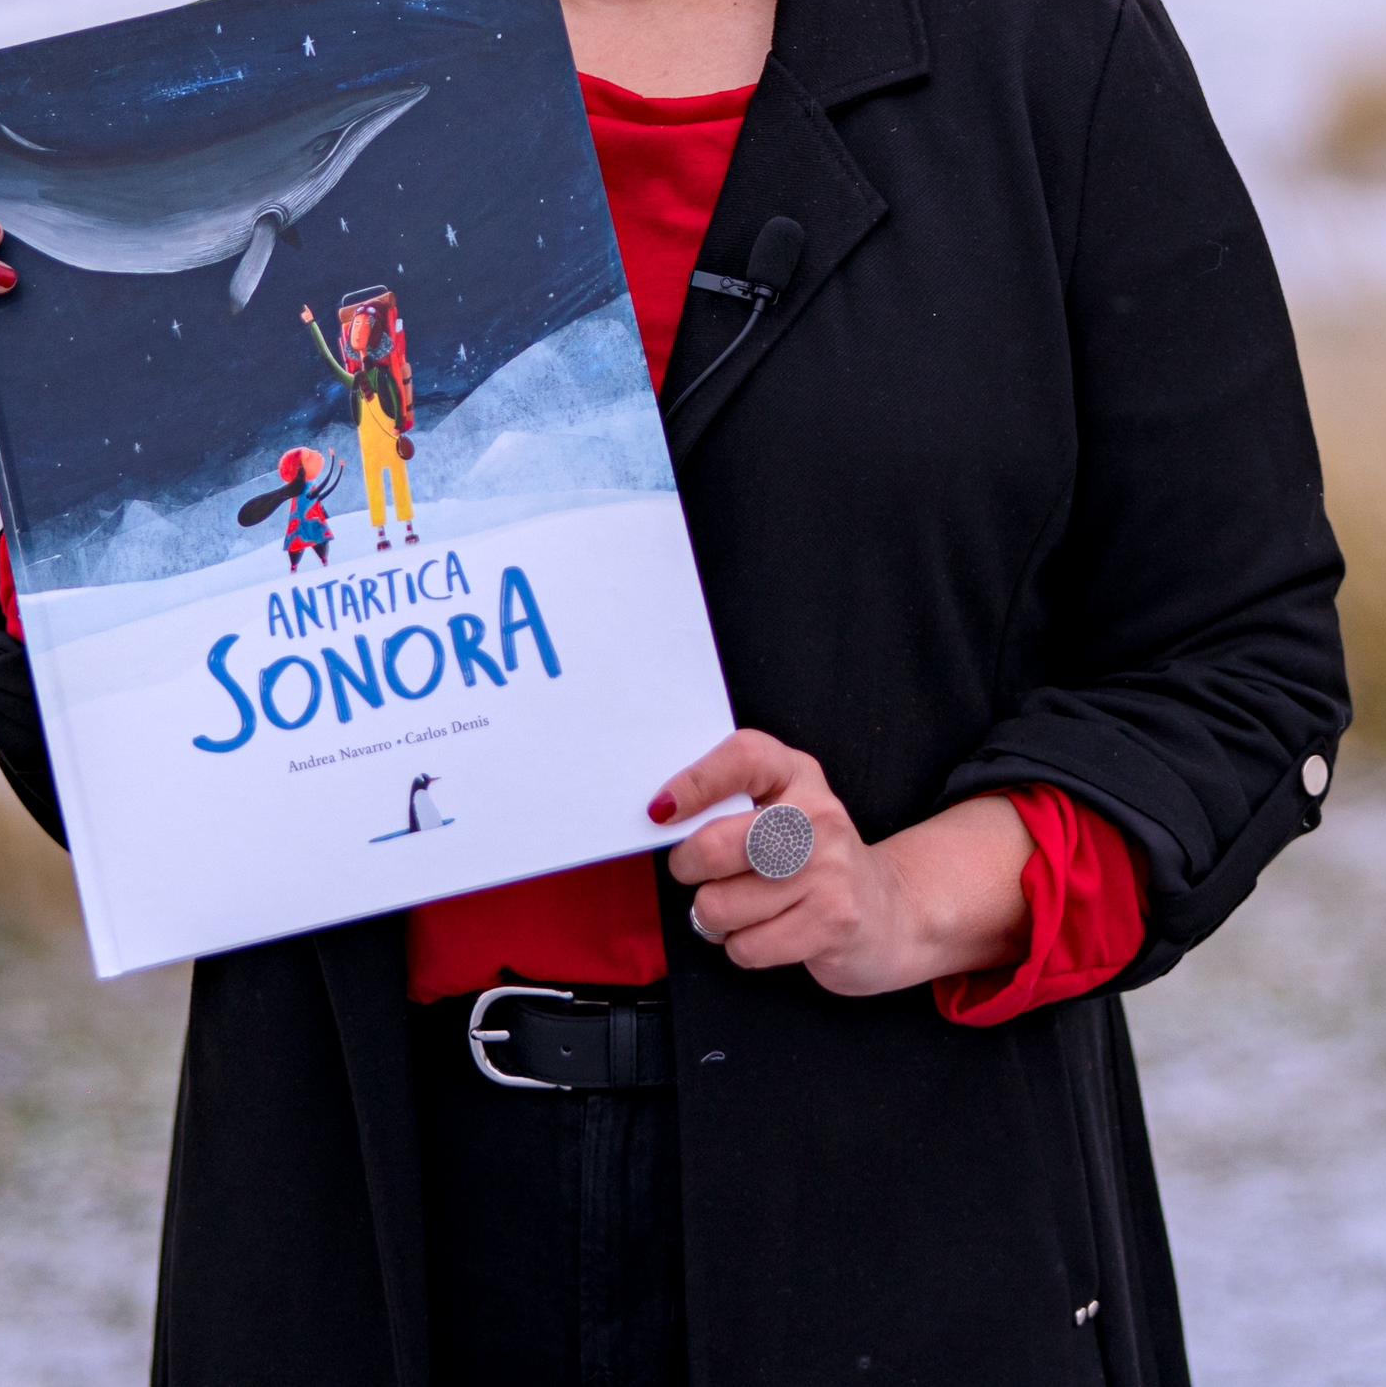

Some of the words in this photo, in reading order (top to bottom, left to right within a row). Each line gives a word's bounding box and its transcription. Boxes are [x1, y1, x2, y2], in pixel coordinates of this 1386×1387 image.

[268, 550, 471, 639] ANTÁRTICA
[192, 566, 562, 753] SONORA
[287, 753, 336, 773] Andrea
[339, 740, 392, 761] Navarro
[404, 727, 447, 745] Carlos
[451, 715, 490, 734] Denis
